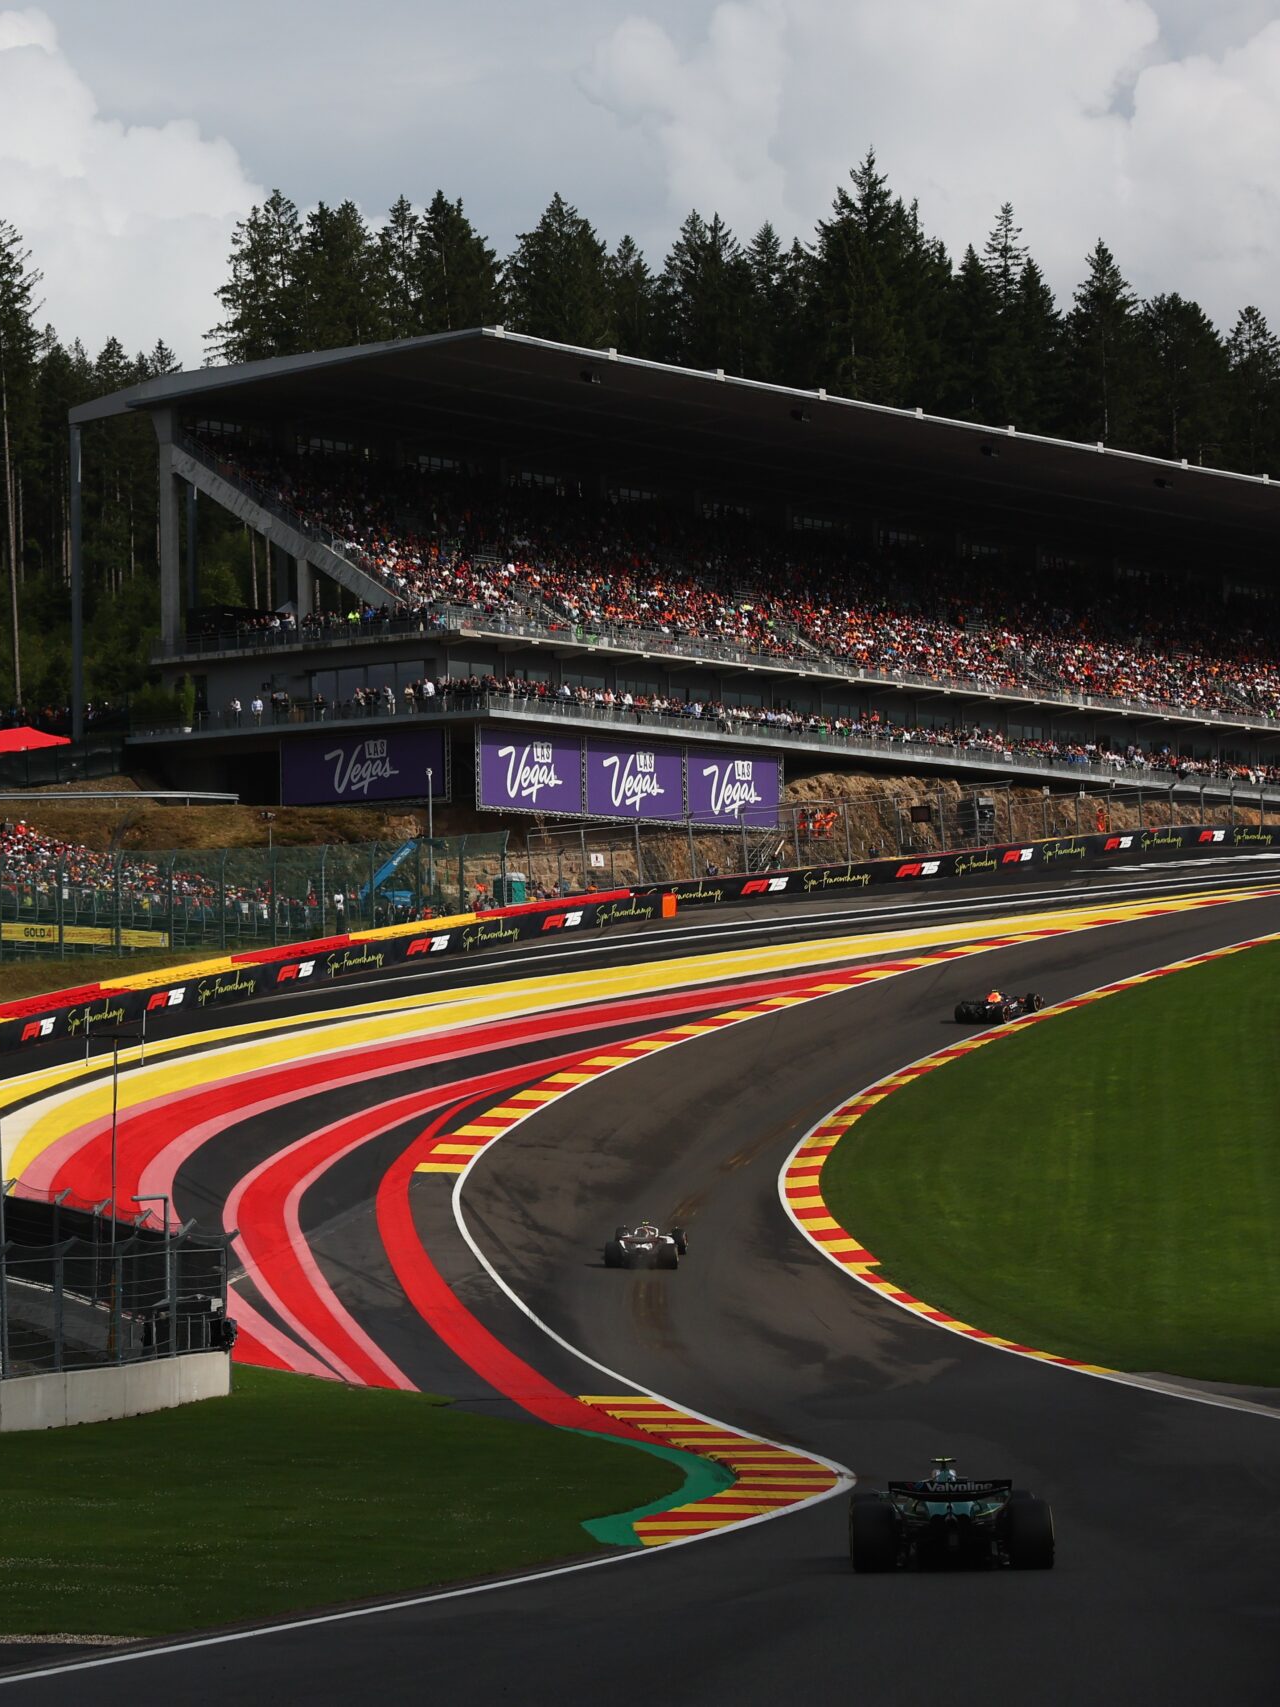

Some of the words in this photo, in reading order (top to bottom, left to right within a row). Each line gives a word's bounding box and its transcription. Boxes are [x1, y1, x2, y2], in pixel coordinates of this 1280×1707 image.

[366, 741, 386, 757] LAS
[534, 742, 552, 762] LAS
[325, 745, 399, 794] Vegas
[638, 753, 654, 771] LAS
[735, 762, 752, 780] LAS
[498, 745, 562, 802] Vegas
[603, 754, 664, 811] Vegas
[703, 763, 761, 819] Vegas
[24, 928, 46, 938] GOLD
[926, 1482, 993, 1492] Valvoline
